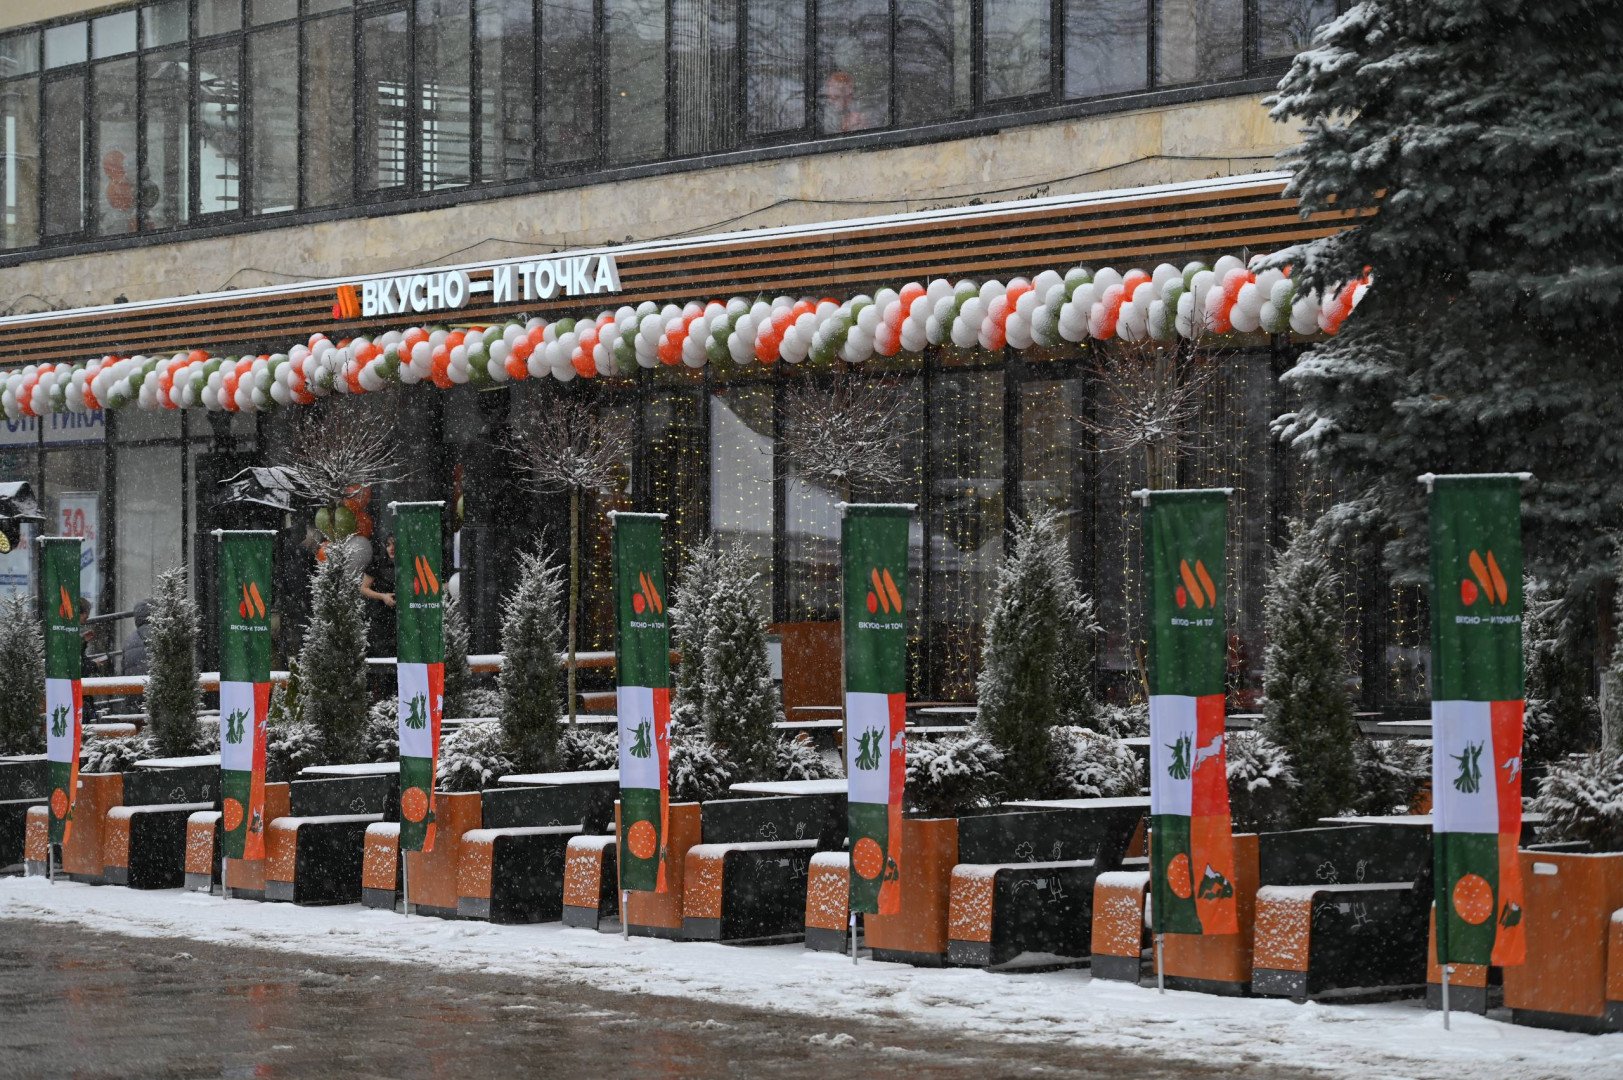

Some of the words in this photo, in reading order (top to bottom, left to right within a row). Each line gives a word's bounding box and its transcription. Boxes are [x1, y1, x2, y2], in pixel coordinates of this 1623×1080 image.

[362, 269, 470, 316] ВКУСНО
[493, 265, 518, 303] И
[518, 255, 621, 301] ТОЧКА
